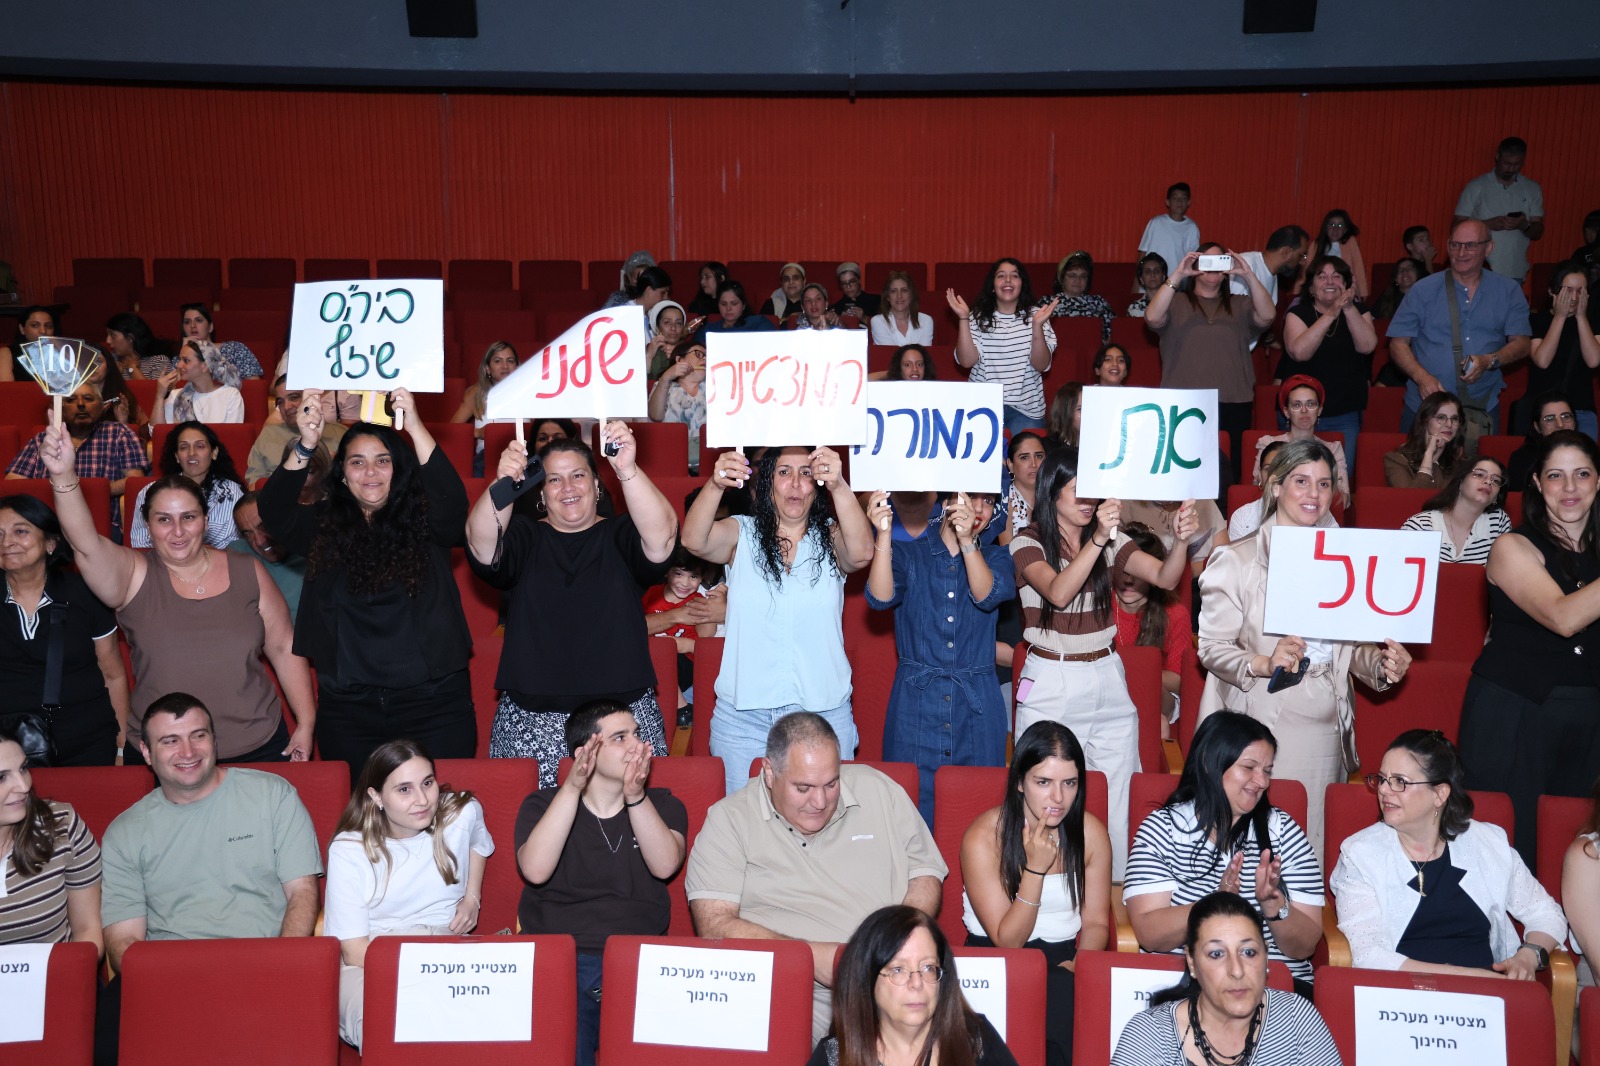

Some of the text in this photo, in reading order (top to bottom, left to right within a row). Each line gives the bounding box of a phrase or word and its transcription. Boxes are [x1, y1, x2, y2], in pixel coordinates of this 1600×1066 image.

[45, 343, 76, 374] 10
[325, 323, 401, 380] שיזף
[1098, 402, 1207, 474] את
[1313, 530, 1426, 616] טל
[420, 963, 517, 975] מצטייני מערכת
[659, 966, 756, 982] מצטייני מערכת
[448, 985, 490, 999] החינוך
[686, 989, 728, 1003] החינוך
[1378, 1009, 1487, 1029] מצטייני מערכת
[1409, 1035, 1458, 1050] החינוך
